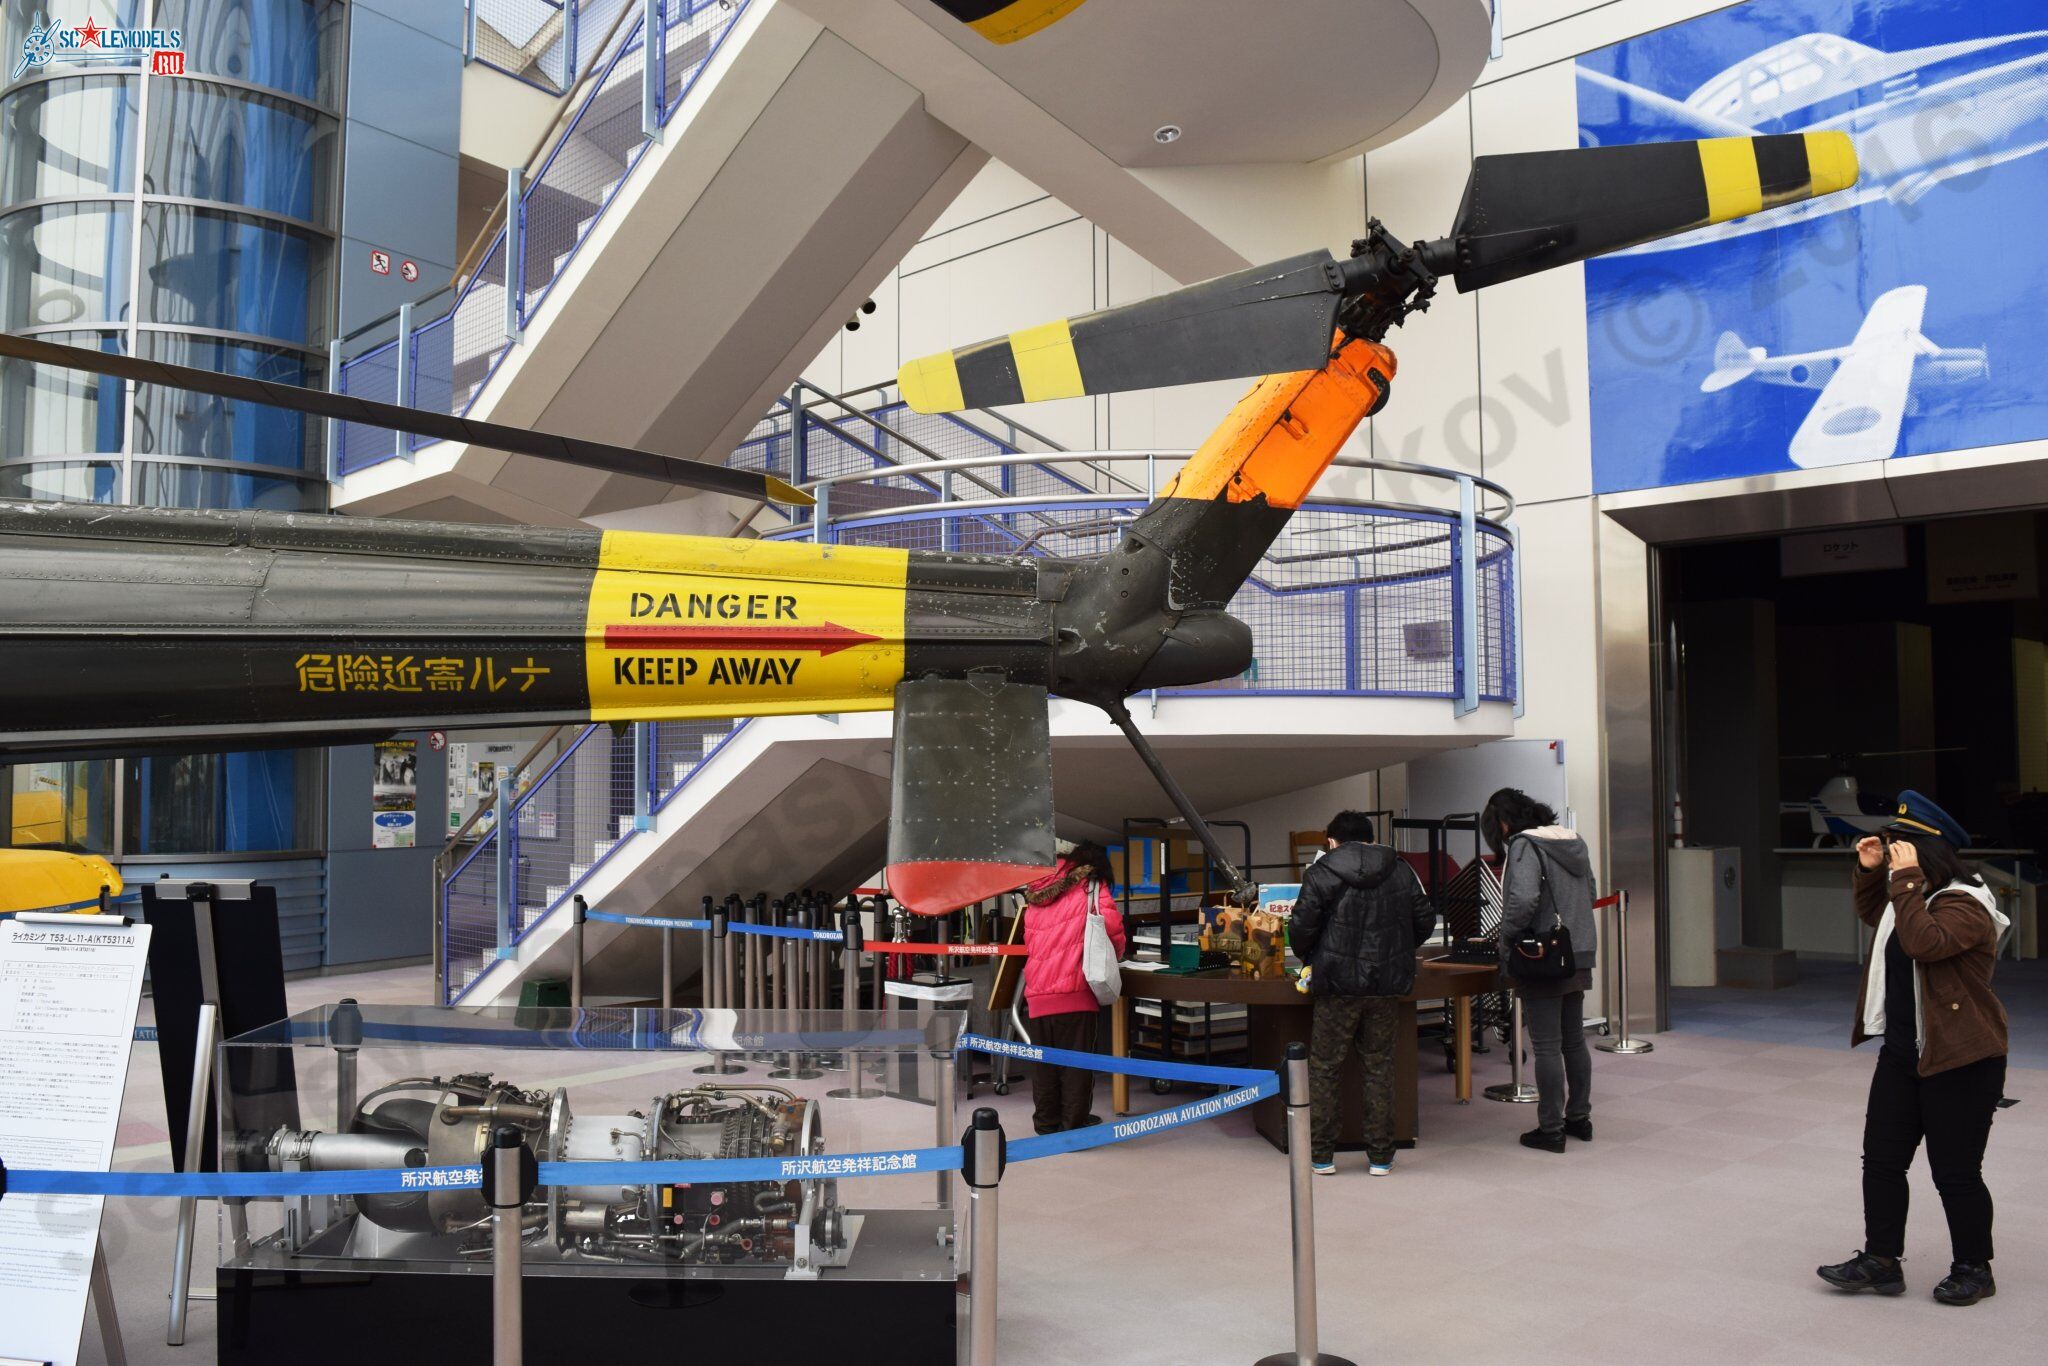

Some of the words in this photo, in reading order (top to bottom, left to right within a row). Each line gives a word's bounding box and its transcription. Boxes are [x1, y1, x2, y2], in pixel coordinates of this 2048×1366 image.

[630, 592, 798, 619] DANGER
[614, 657, 698, 685] KEEP
[708, 657, 801, 685] AWAY
[12, 932, 47, 942] ライカミング
[969, 1036, 1043, 1060] 所沢航空発祥記念館
[1113, 1112, 1178, 1139] TOKOROZAWA
[1180, 1098, 1222, 1122] AVIATION
[1223, 1086, 1260, 1109] MUSEUM
[781, 1153, 917, 1176] 所沢航空発祥記念館
[400, 1168, 483, 1188] 所沢航空発
